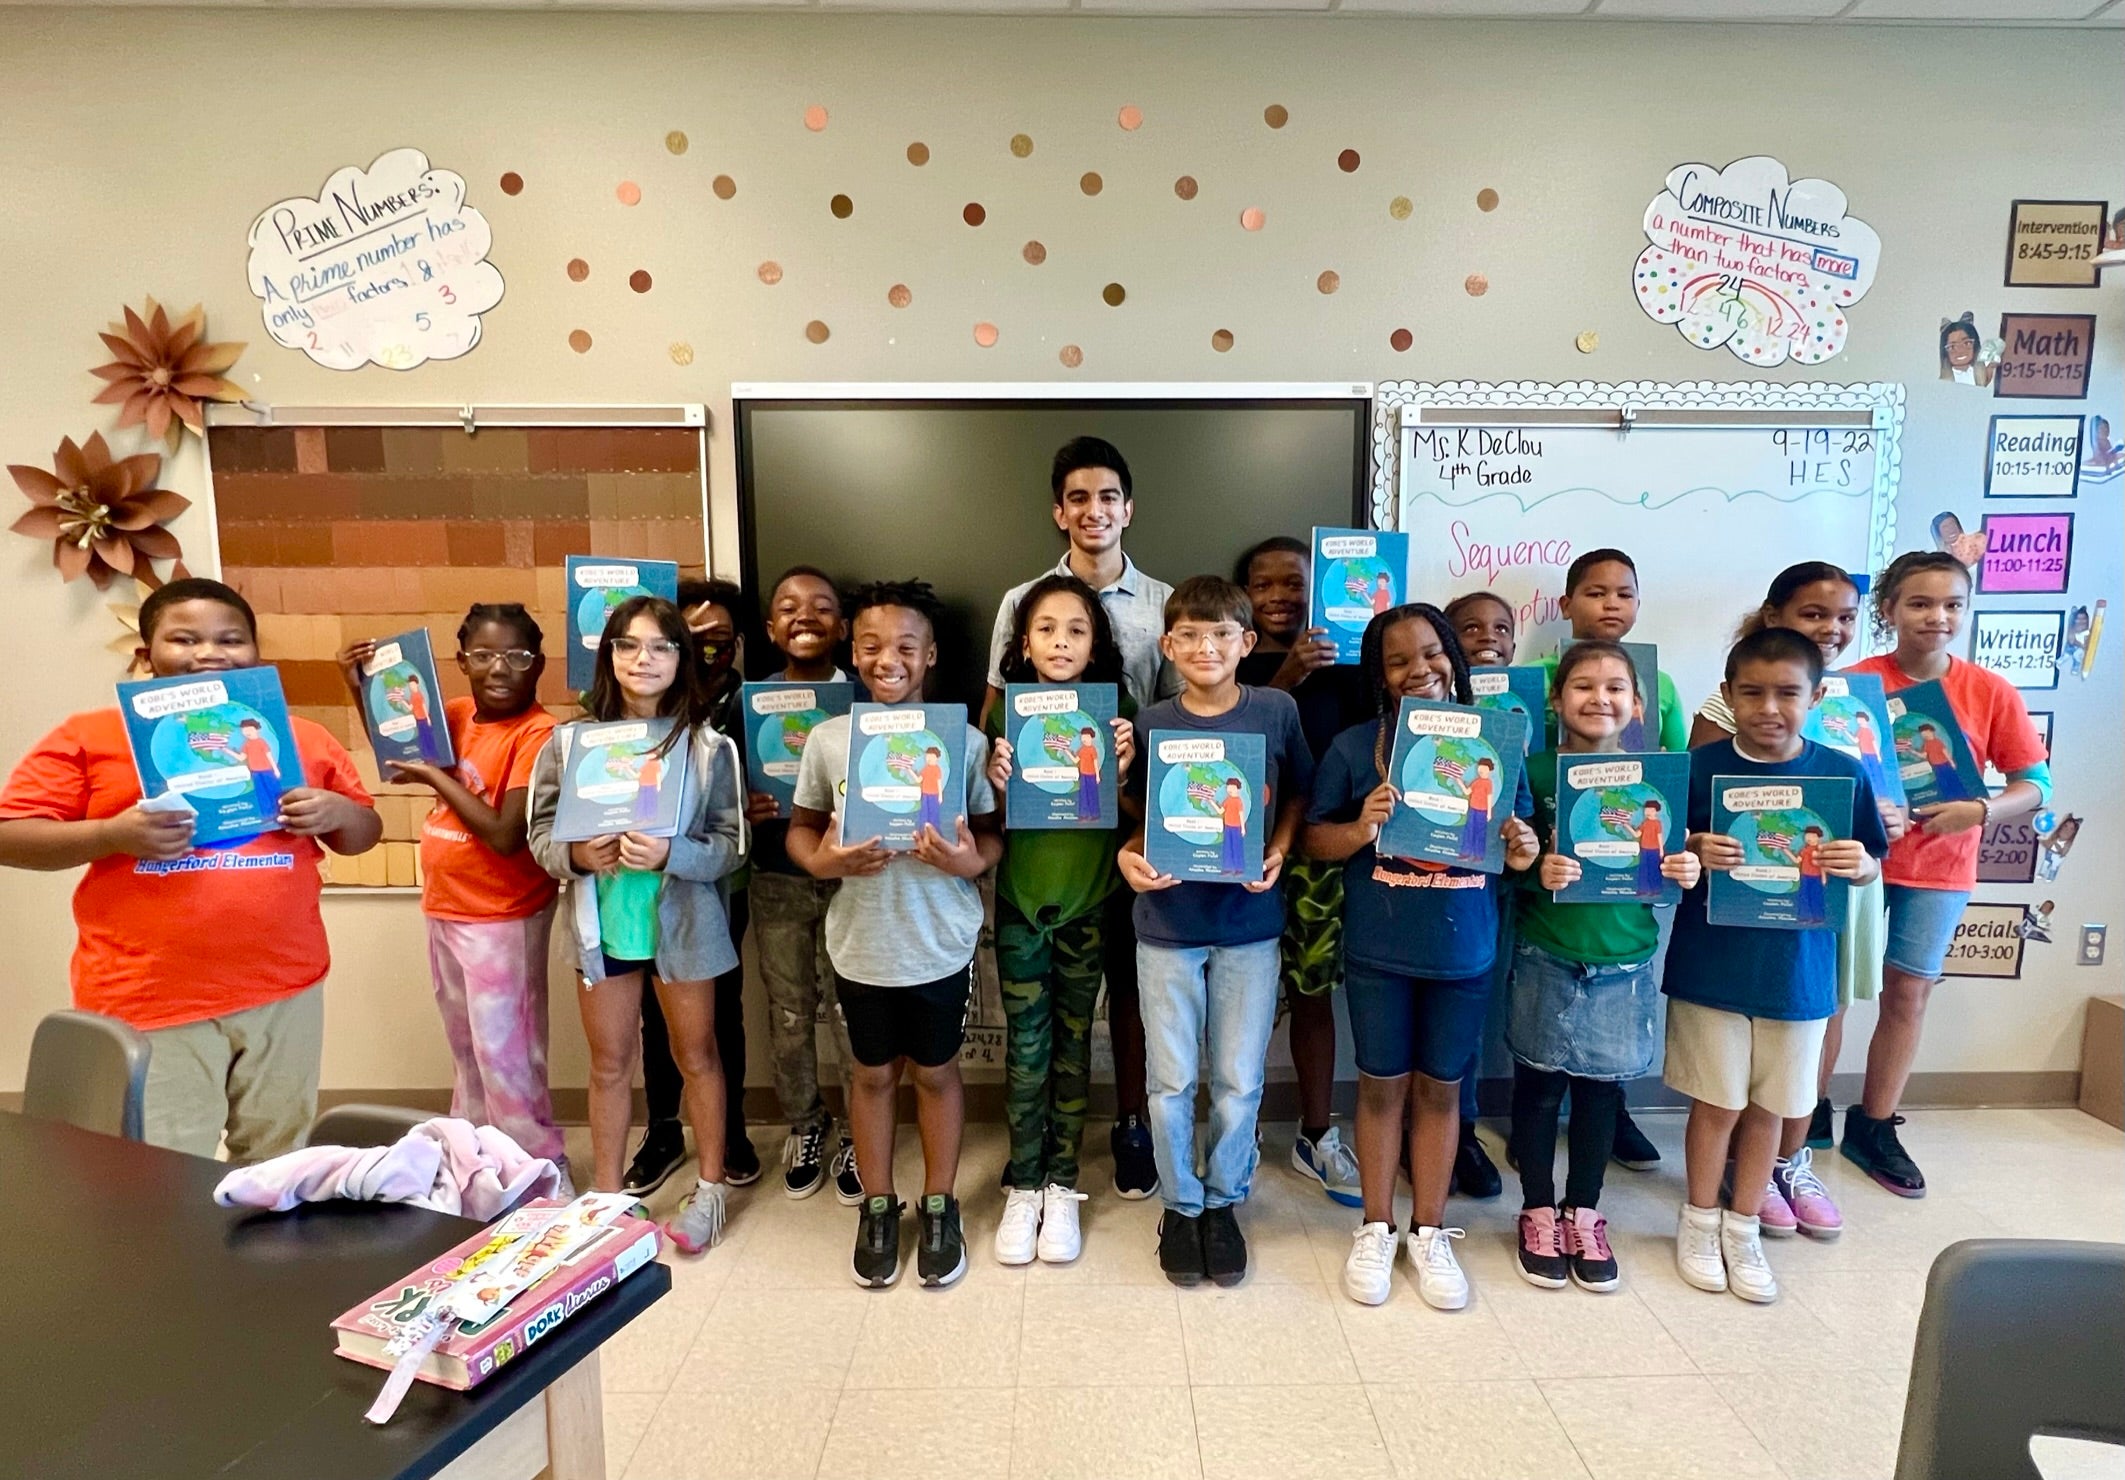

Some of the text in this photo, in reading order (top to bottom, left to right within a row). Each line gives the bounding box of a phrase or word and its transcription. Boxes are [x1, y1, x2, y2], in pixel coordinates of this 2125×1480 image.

[1679, 170, 1841, 238] COMPOSITE NUMBERS
[272, 208, 342, 255] PRIME
[2017, 220, 2099, 236] Intervention
[1652, 214, 1852, 275] a number that has more
[2018, 243, 2092, 261] 8:45-9:15
[262, 217, 466, 303] A prime number has
[1668, 237, 1709, 264] than
[1716, 250, 1746, 273] two
[438, 284, 457, 306] 3
[1716, 274, 1745, 301] 24
[272, 304, 316, 331] only
[415, 312, 432, 332] 5
[1766, 317, 1784, 338] 12
[307, 331, 323, 351] 2
[2013, 329, 2079, 357] Math
[2002, 361, 2084, 380] 9:15-10:15
[1413, 428, 1543, 462] Ms. K DeClou
[1772, 428, 1875, 456] 9-19-22
[1996, 431, 2077, 457] Reading
[1439, 460, 1533, 491] 4th Grade
[1995, 461, 2073, 476] 10:15-11:00
[1986, 526, 2062, 554] Lunch
[1448, 520, 1574, 588] Sequence
[1986, 558, 2064, 573] 11:00-11:25
[1979, 629, 2057, 655] Writing
[1976, 655, 2054, 670] 11:45-12:15
[179, 683, 222, 697] WORLD
[1046, 692, 1076, 701] WORLD
[148, 694, 217, 714] ADVENTURE
[1416, 724, 1471, 735] ADVENTURE
[1445, 715, 1480, 726] WORLD
[1191, 741, 1223, 751] WORLD
[1605, 764, 1640, 774] WORLD
[1576, 774, 1633, 786] ADVENTURE
[1762, 787, 1800, 797] WORLD
[1732, 798, 1793, 808] ADVENTURE
[1979, 850, 2028, 864] 5-2:00
[1953, 920, 2020, 942] pecials
[527, 1306, 563, 1343] DORK
